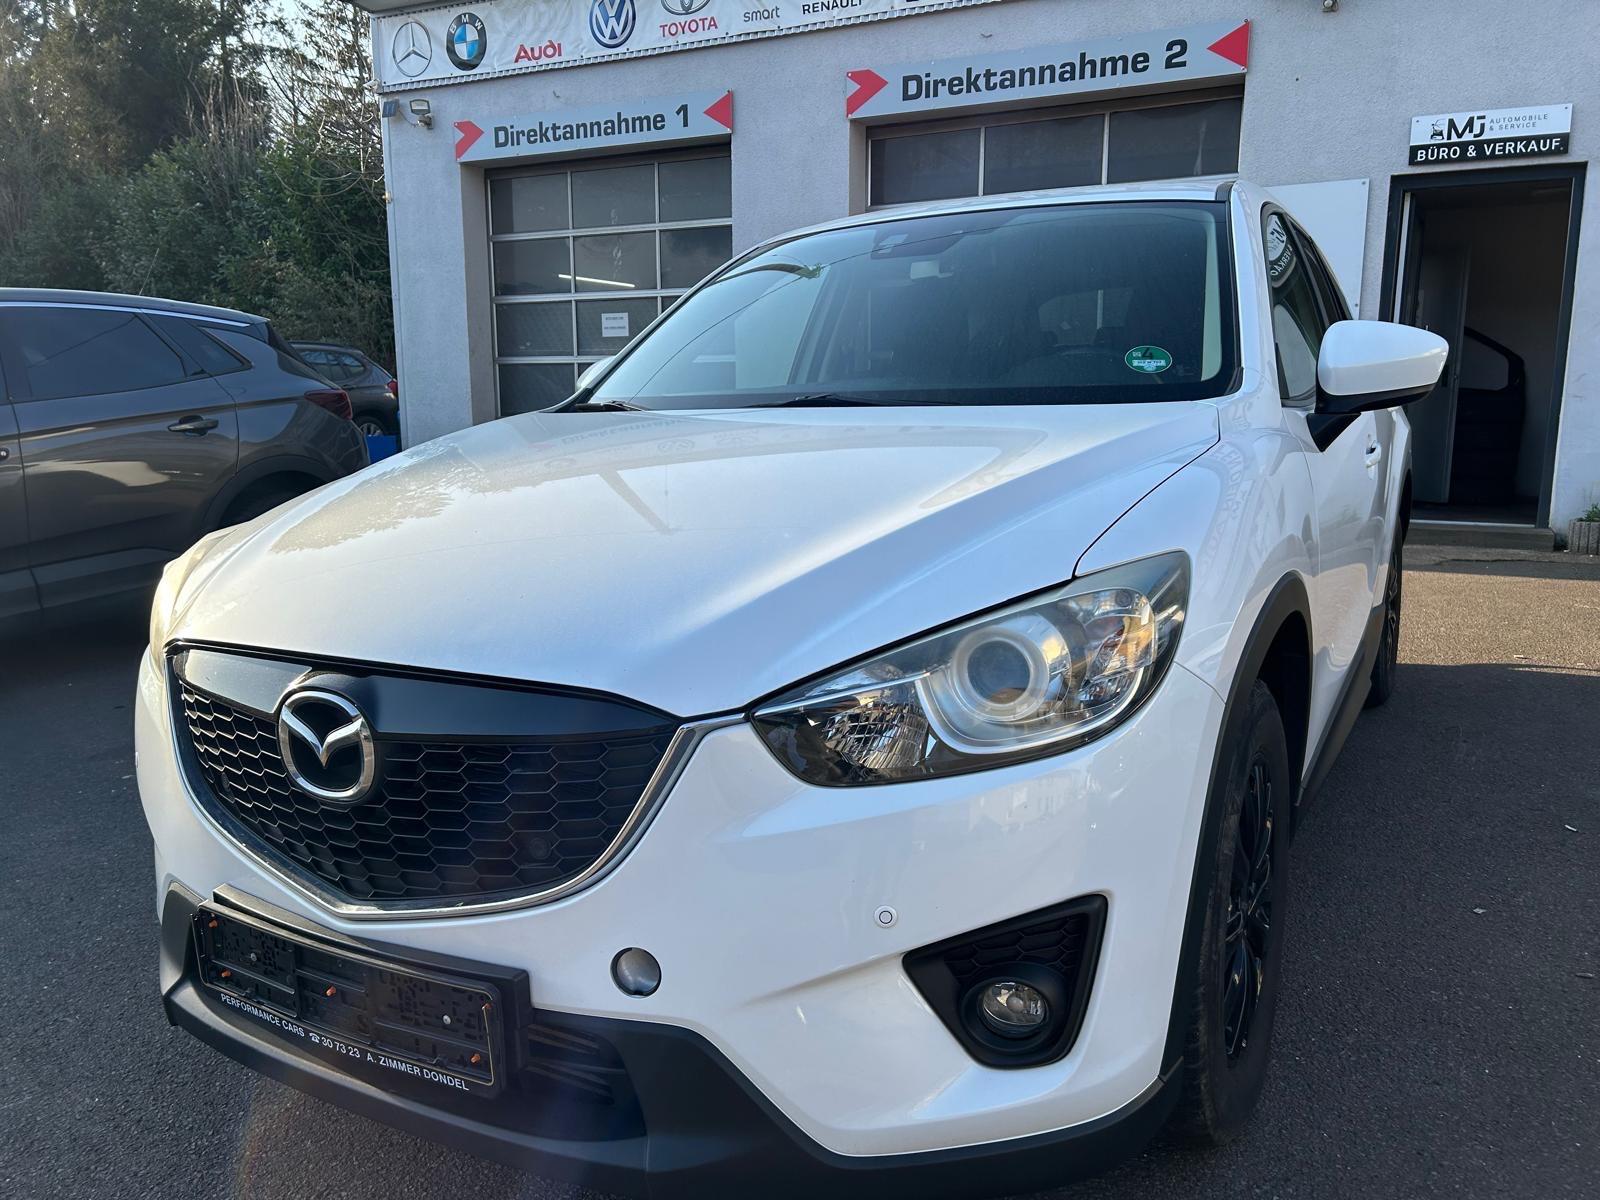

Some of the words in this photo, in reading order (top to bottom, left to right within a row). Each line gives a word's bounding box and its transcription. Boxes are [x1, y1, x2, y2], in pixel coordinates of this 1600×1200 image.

[449, 14, 482, 34] BMW
[743, 5, 780, 22] smart
[660, 16, 718, 38] TOYOTA
[514, 40, 562, 63] Audi
[902, 52, 1150, 101] Direktannahme
[1165, 39, 1188, 70] 2
[494, 112, 666, 148] Direktannahme
[676, 104, 688, 127] 1
[1489, 114, 1548, 124] AUTOMOBILE
[1499, 122, 1537, 130] SERVICE
[1417, 146, 1460, 162] BÜRO
[1467, 145, 1477, 157] &
[1484, 138, 1561, 155] VERKAUF
[221, 993, 280, 1026] PERFORMANCE
[282, 1020, 304, 1037] CARS
[321, 1037, 332, 1049] 30
[334, 1042, 346, 1054] 73
[348, 1047, 361, 1058] 23
[367, 1053, 377, 1063] A.
[379, 1055, 421, 1076] ZIMMER
[423, 1069, 469, 1091] DONDEL
